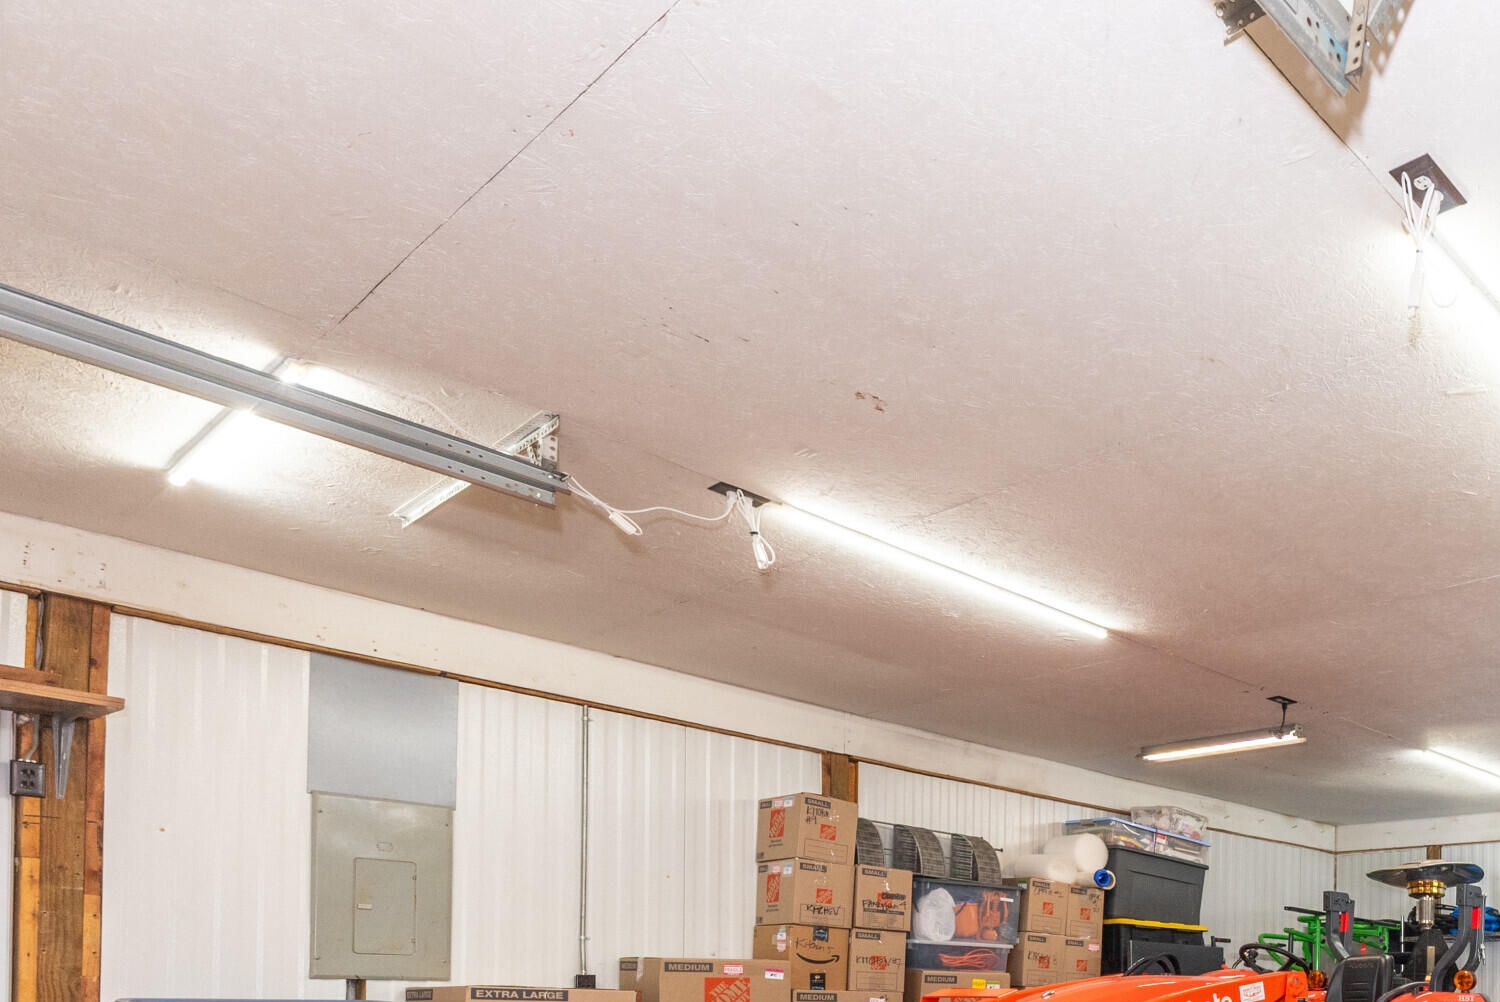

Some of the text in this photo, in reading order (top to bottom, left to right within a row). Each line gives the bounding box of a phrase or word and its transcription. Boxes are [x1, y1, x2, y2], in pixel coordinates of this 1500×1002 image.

[668, 963, 710, 972] MEDIUM
[927, 976, 956, 984] MEDIUM
[475, 989, 564, 1000] EXTRA LARGE
[799, 993, 835, 1001] MEDIUM
